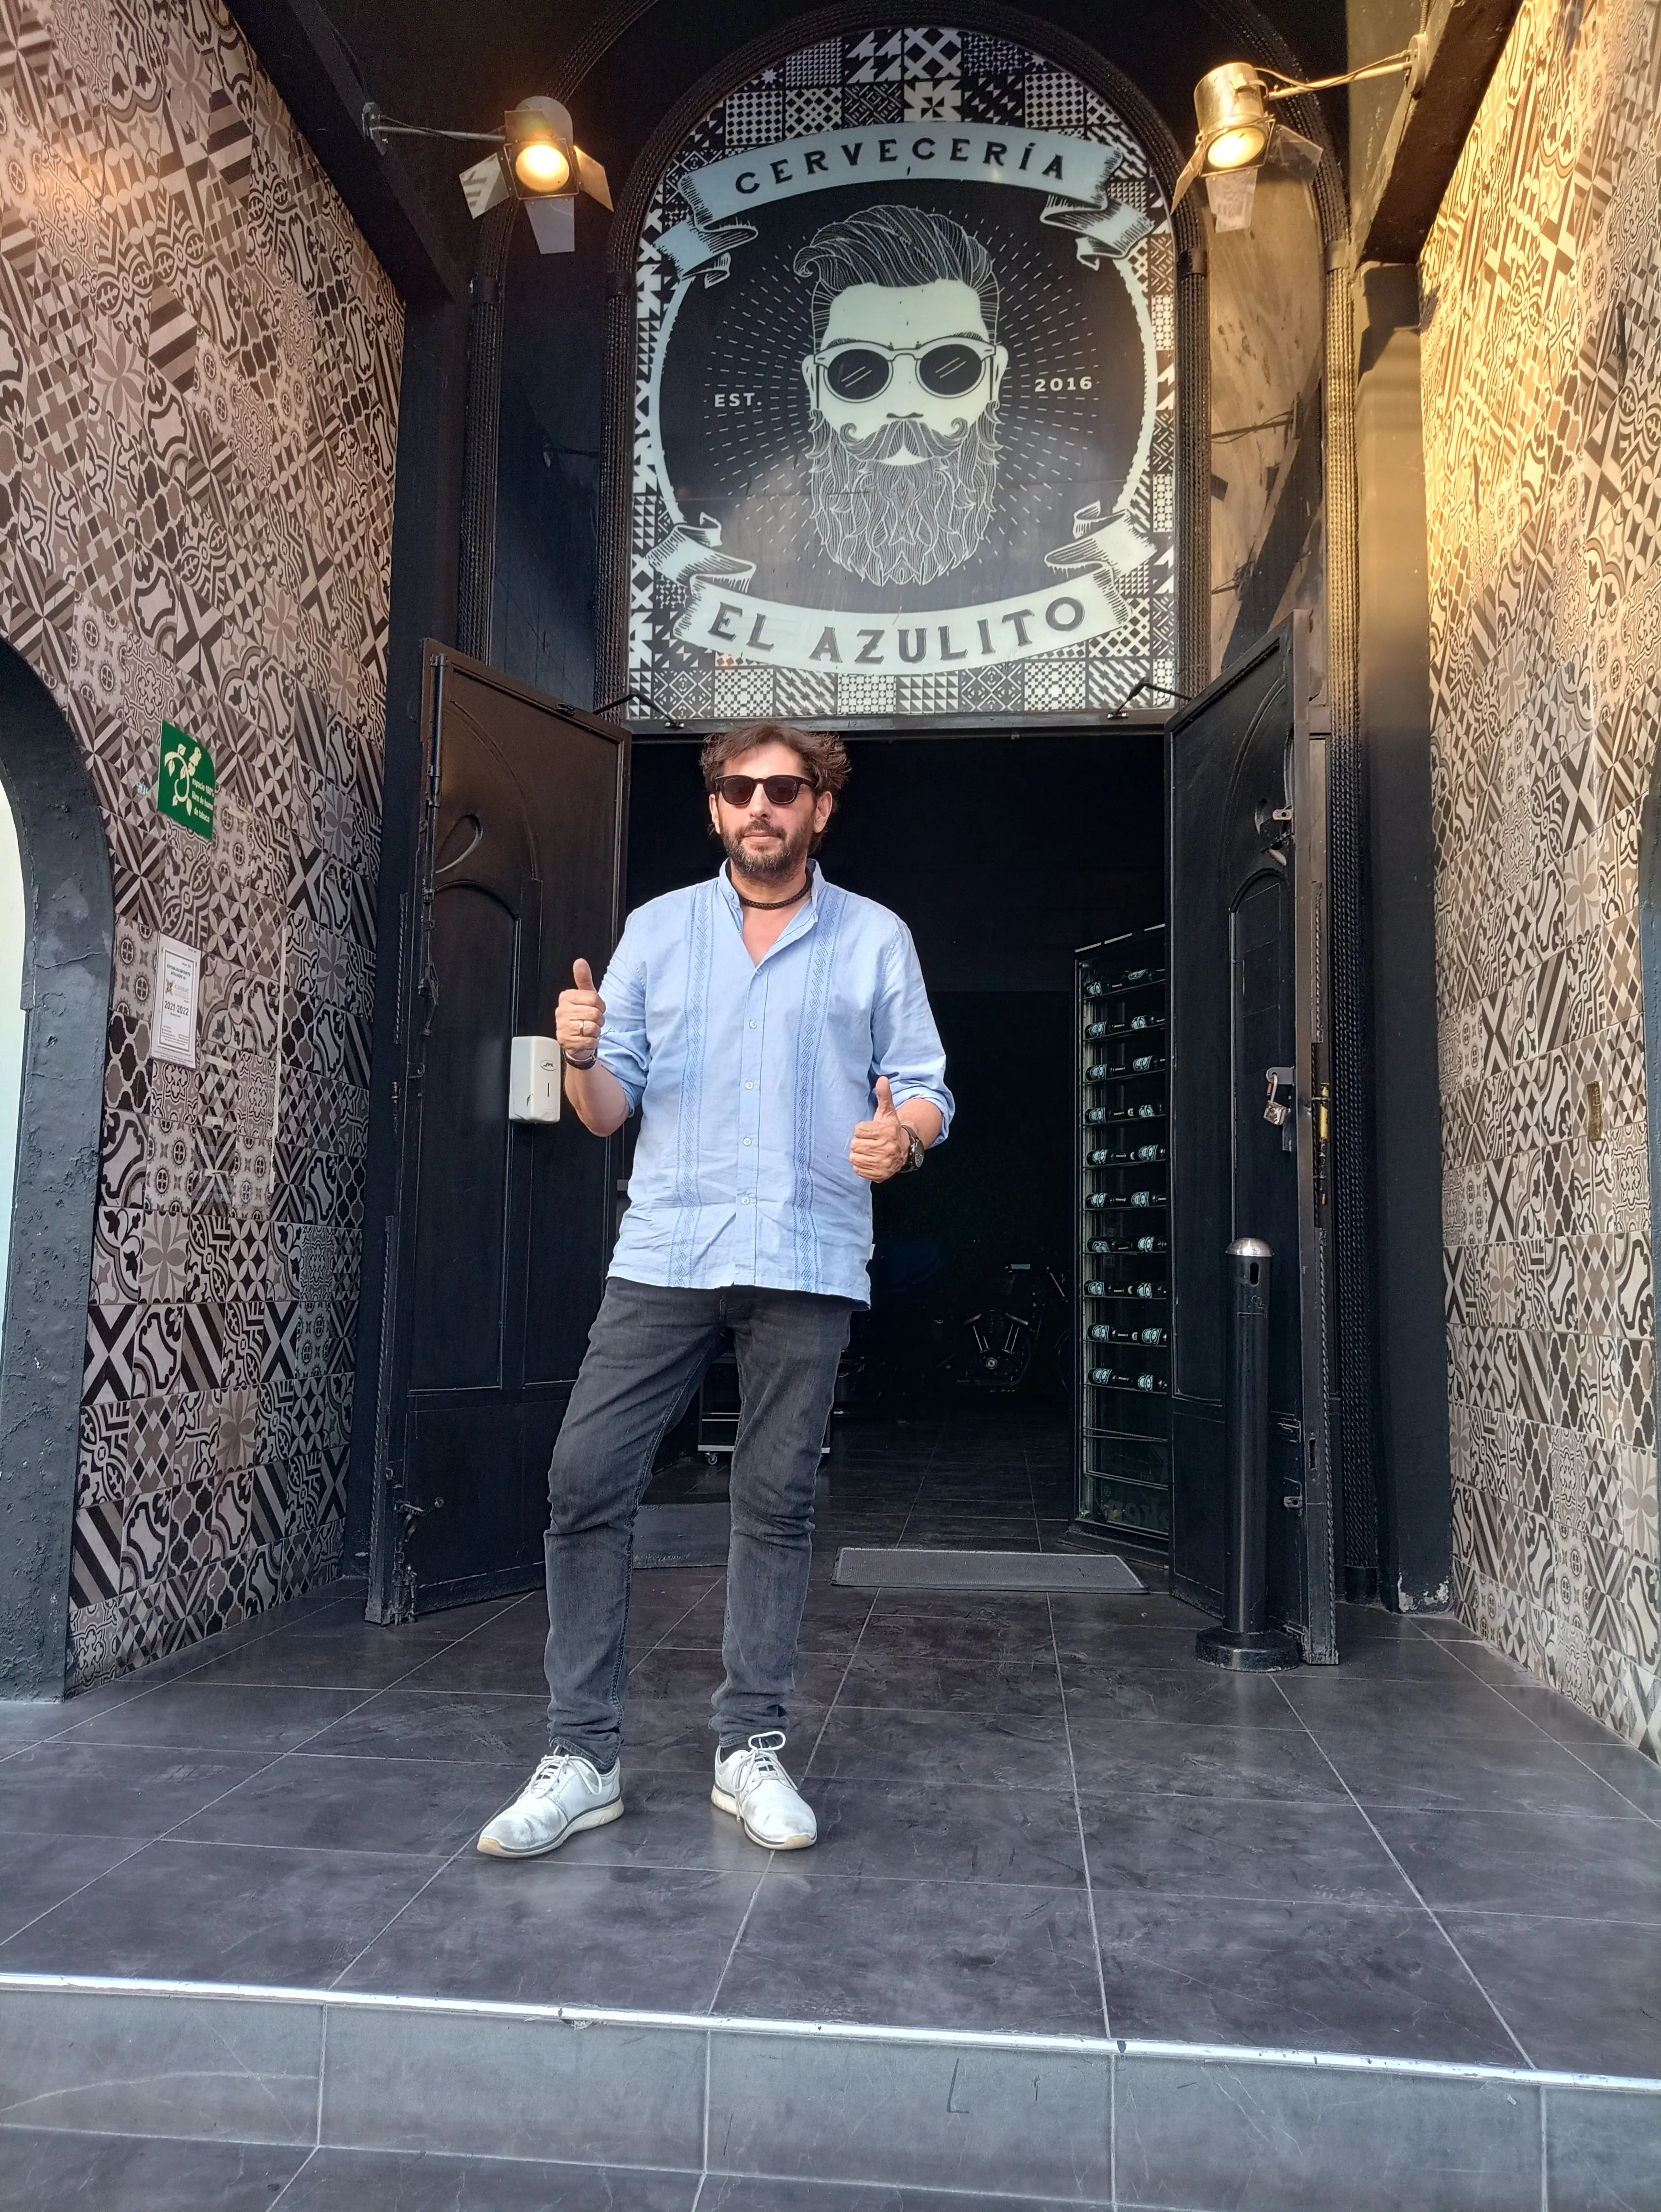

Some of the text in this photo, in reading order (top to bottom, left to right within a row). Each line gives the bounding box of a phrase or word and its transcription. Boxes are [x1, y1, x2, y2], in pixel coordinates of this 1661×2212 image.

[735, 137, 1063, 194] CERVECERÍA
[1035, 376, 1092, 392] 2016
[715, 392, 762, 408] EST.
[708, 597, 1085, 664] EL AZULITO
[165, 1000, 189, 1016] 2021-2022
